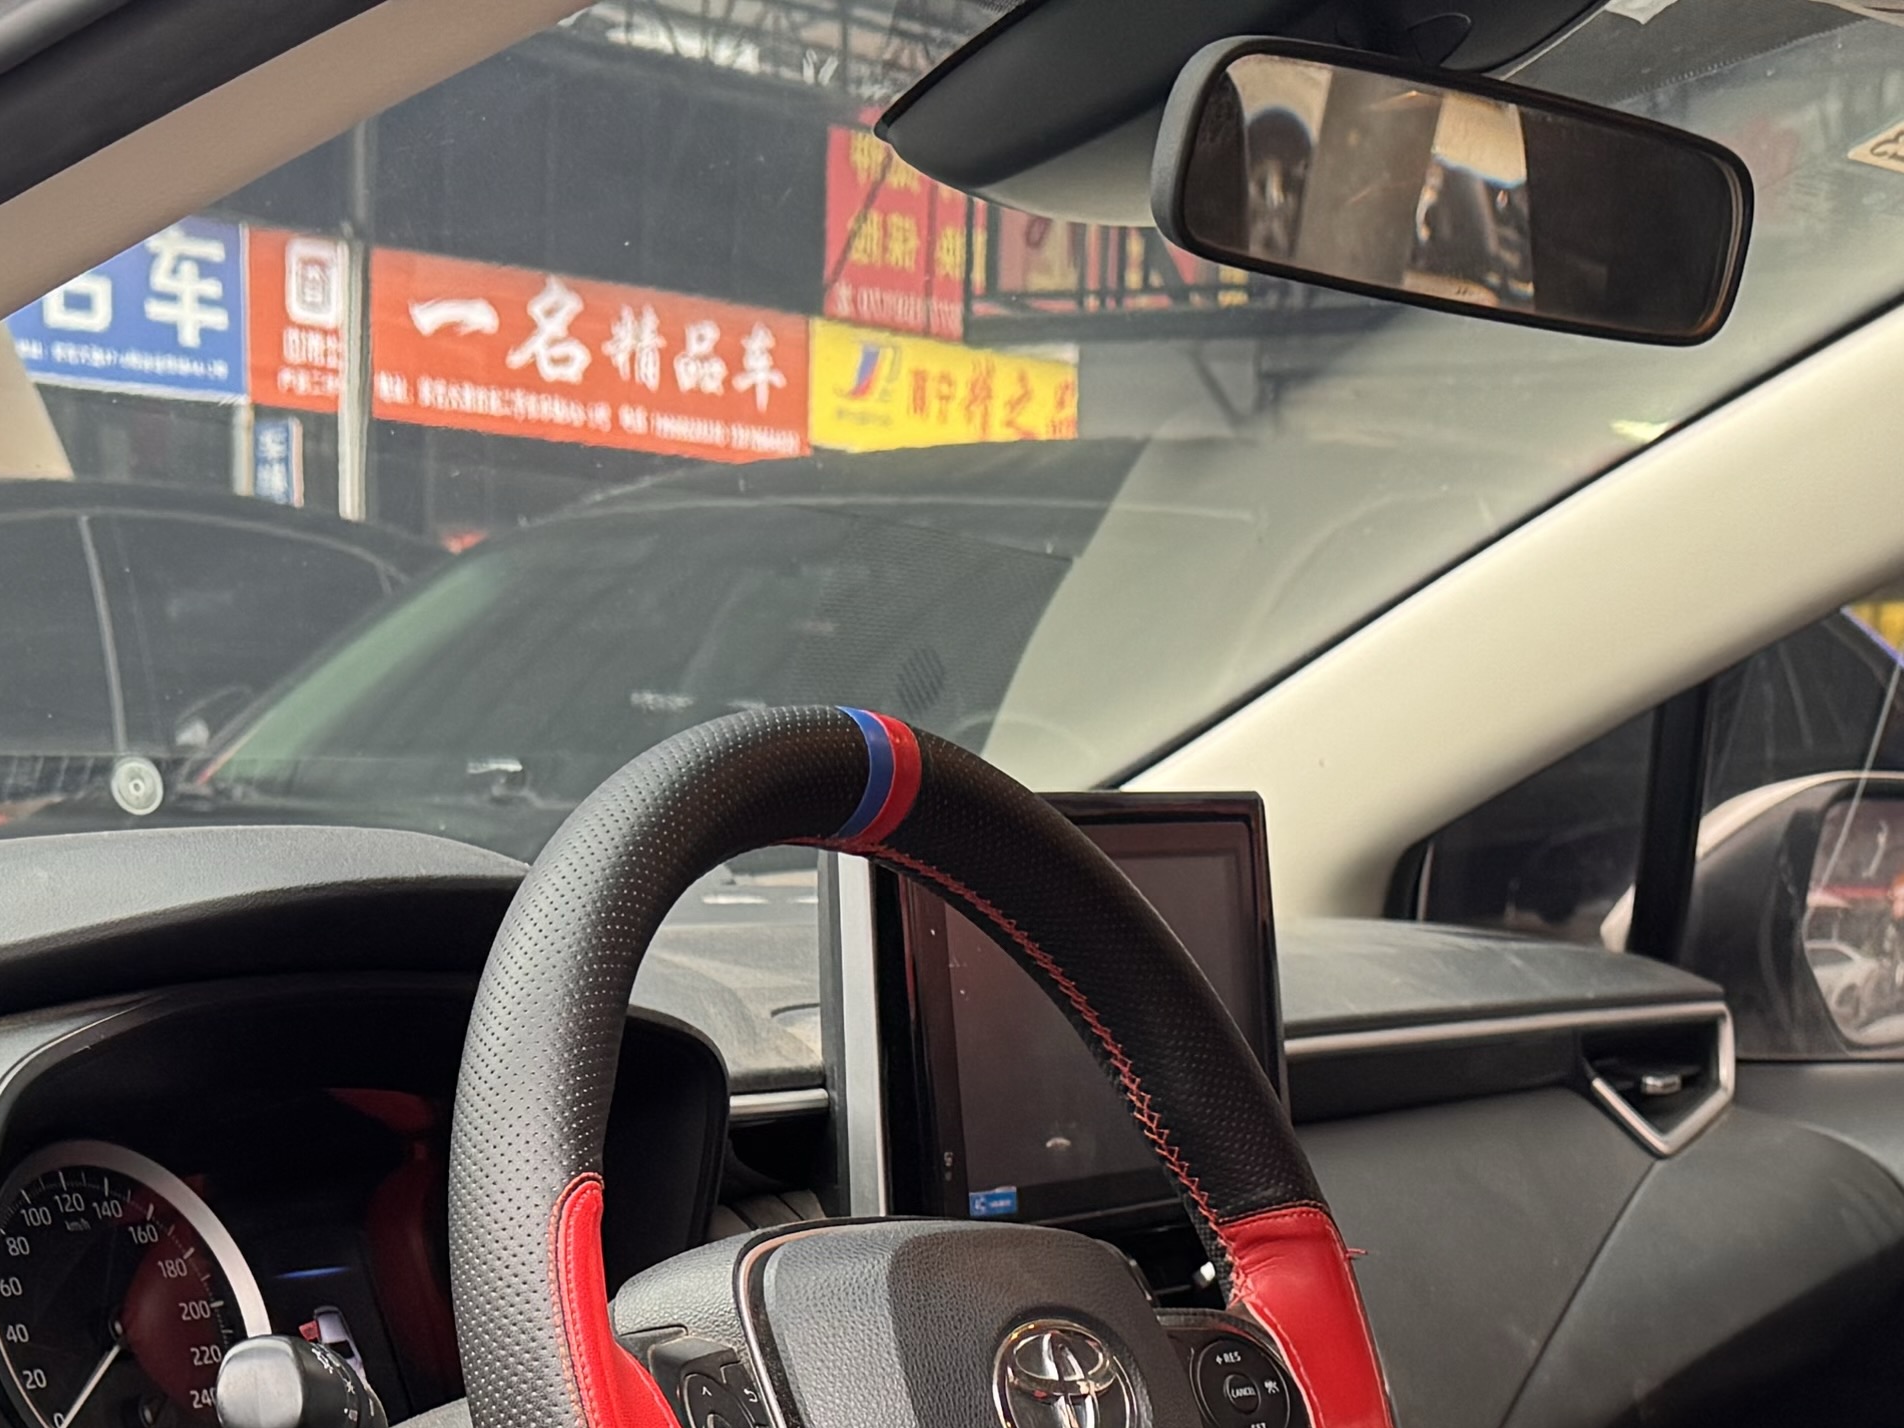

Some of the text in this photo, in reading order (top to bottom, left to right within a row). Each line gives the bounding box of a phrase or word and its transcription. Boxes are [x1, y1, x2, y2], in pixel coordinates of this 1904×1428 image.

[408, 275, 788, 413] 一名精品车
[54, 1192, 85, 1213] 120
[93, 1199, 124, 1219] 140
[20, 1206, 53, 1228] 100
[128, 1225, 158, 1244] 160
[5, 1236, 30, 1256] 80
[158, 1258, 188, 1279] 180
[0, 1276, 23, 1297] 60
[178, 1300, 211, 1321] 200
[5, 1323, 30, 1343] 40
[190, 1344, 222, 1366] 220
[22, 1368, 47, 1390] 20
